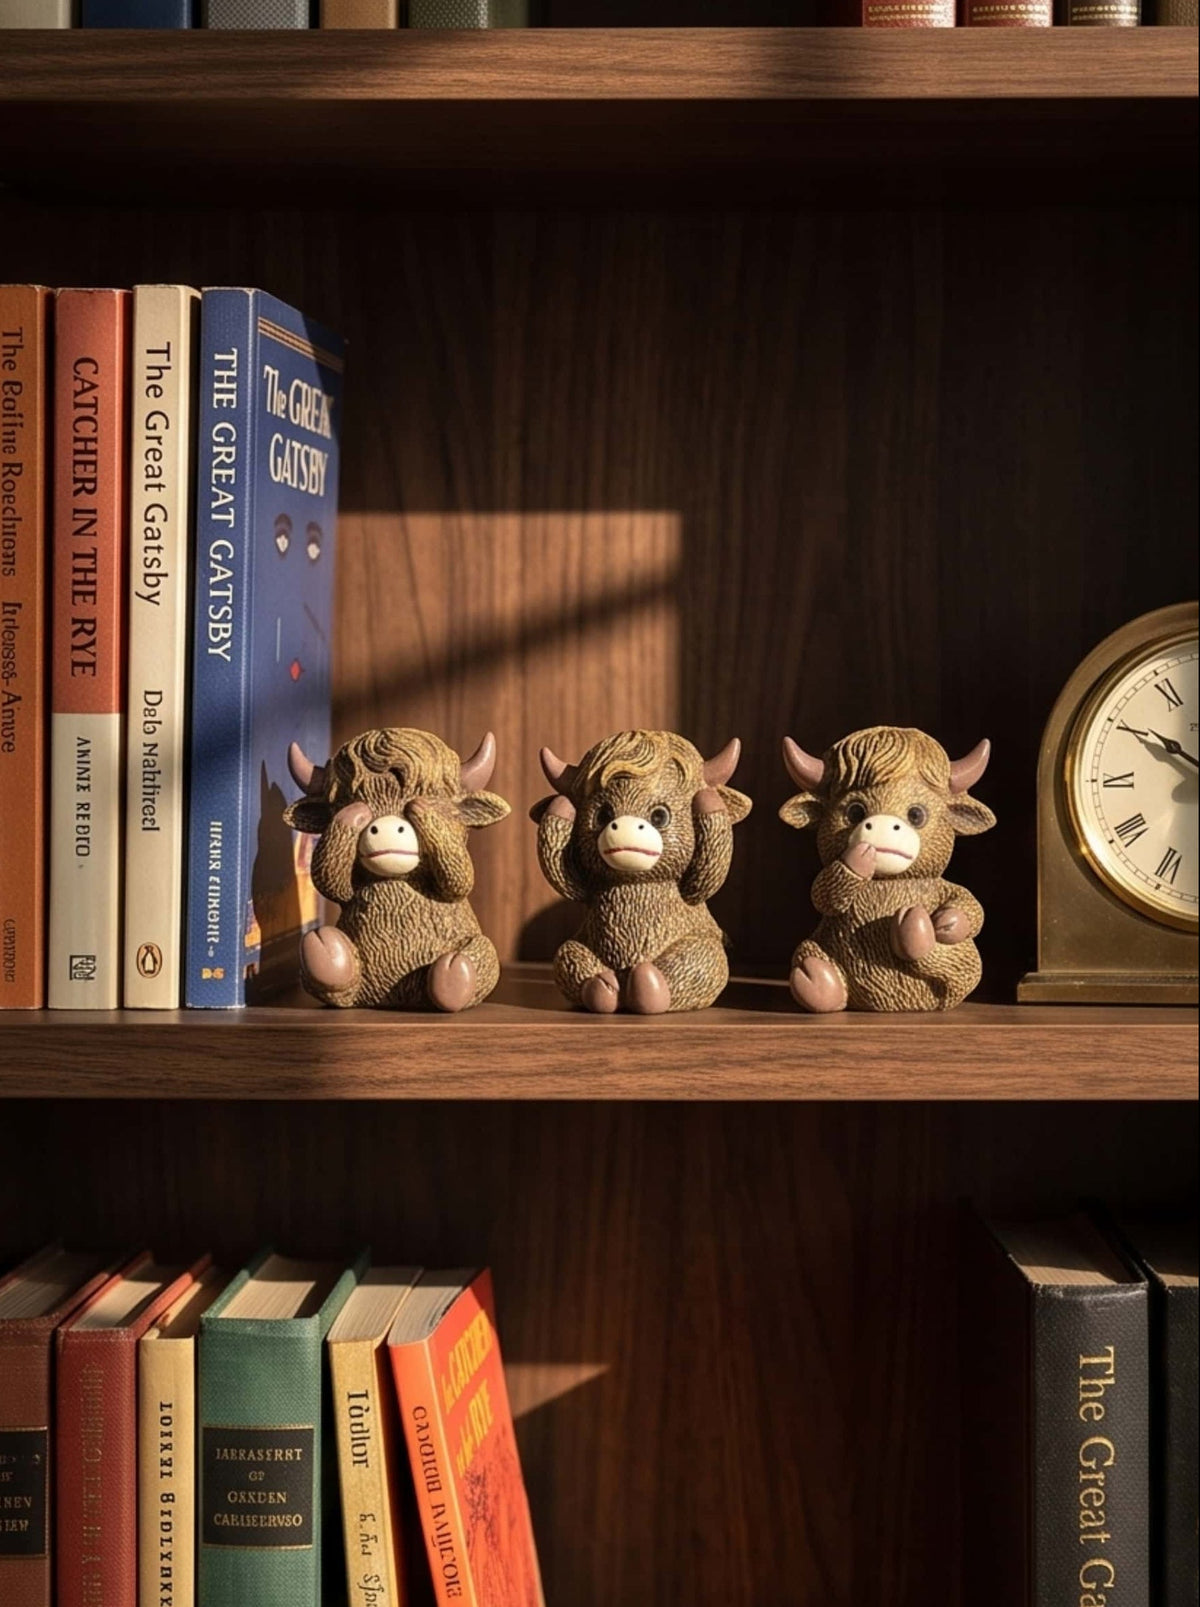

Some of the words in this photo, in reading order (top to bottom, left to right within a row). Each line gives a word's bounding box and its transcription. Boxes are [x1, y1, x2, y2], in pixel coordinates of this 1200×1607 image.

[2, 327, 22, 372] The
[145, 341, 171, 399] The
[213, 348, 238, 409] THE
[263, 364, 287, 419] The
[72, 357, 99, 497] CATCHER
[144, 410, 169, 492] Great
[211, 422, 237, 528] GREAT
[269, 432, 328, 497] GATSBY
[72, 508, 97, 537] IN
[135, 503, 168, 606] Gatsby
[71, 547, 97, 605] THE
[207, 540, 234, 662] GATSBY
[71, 616, 97, 678] RYE
[1080, 1345, 1115, 1422] The
[1080, 1436, 1115, 1544] Great
